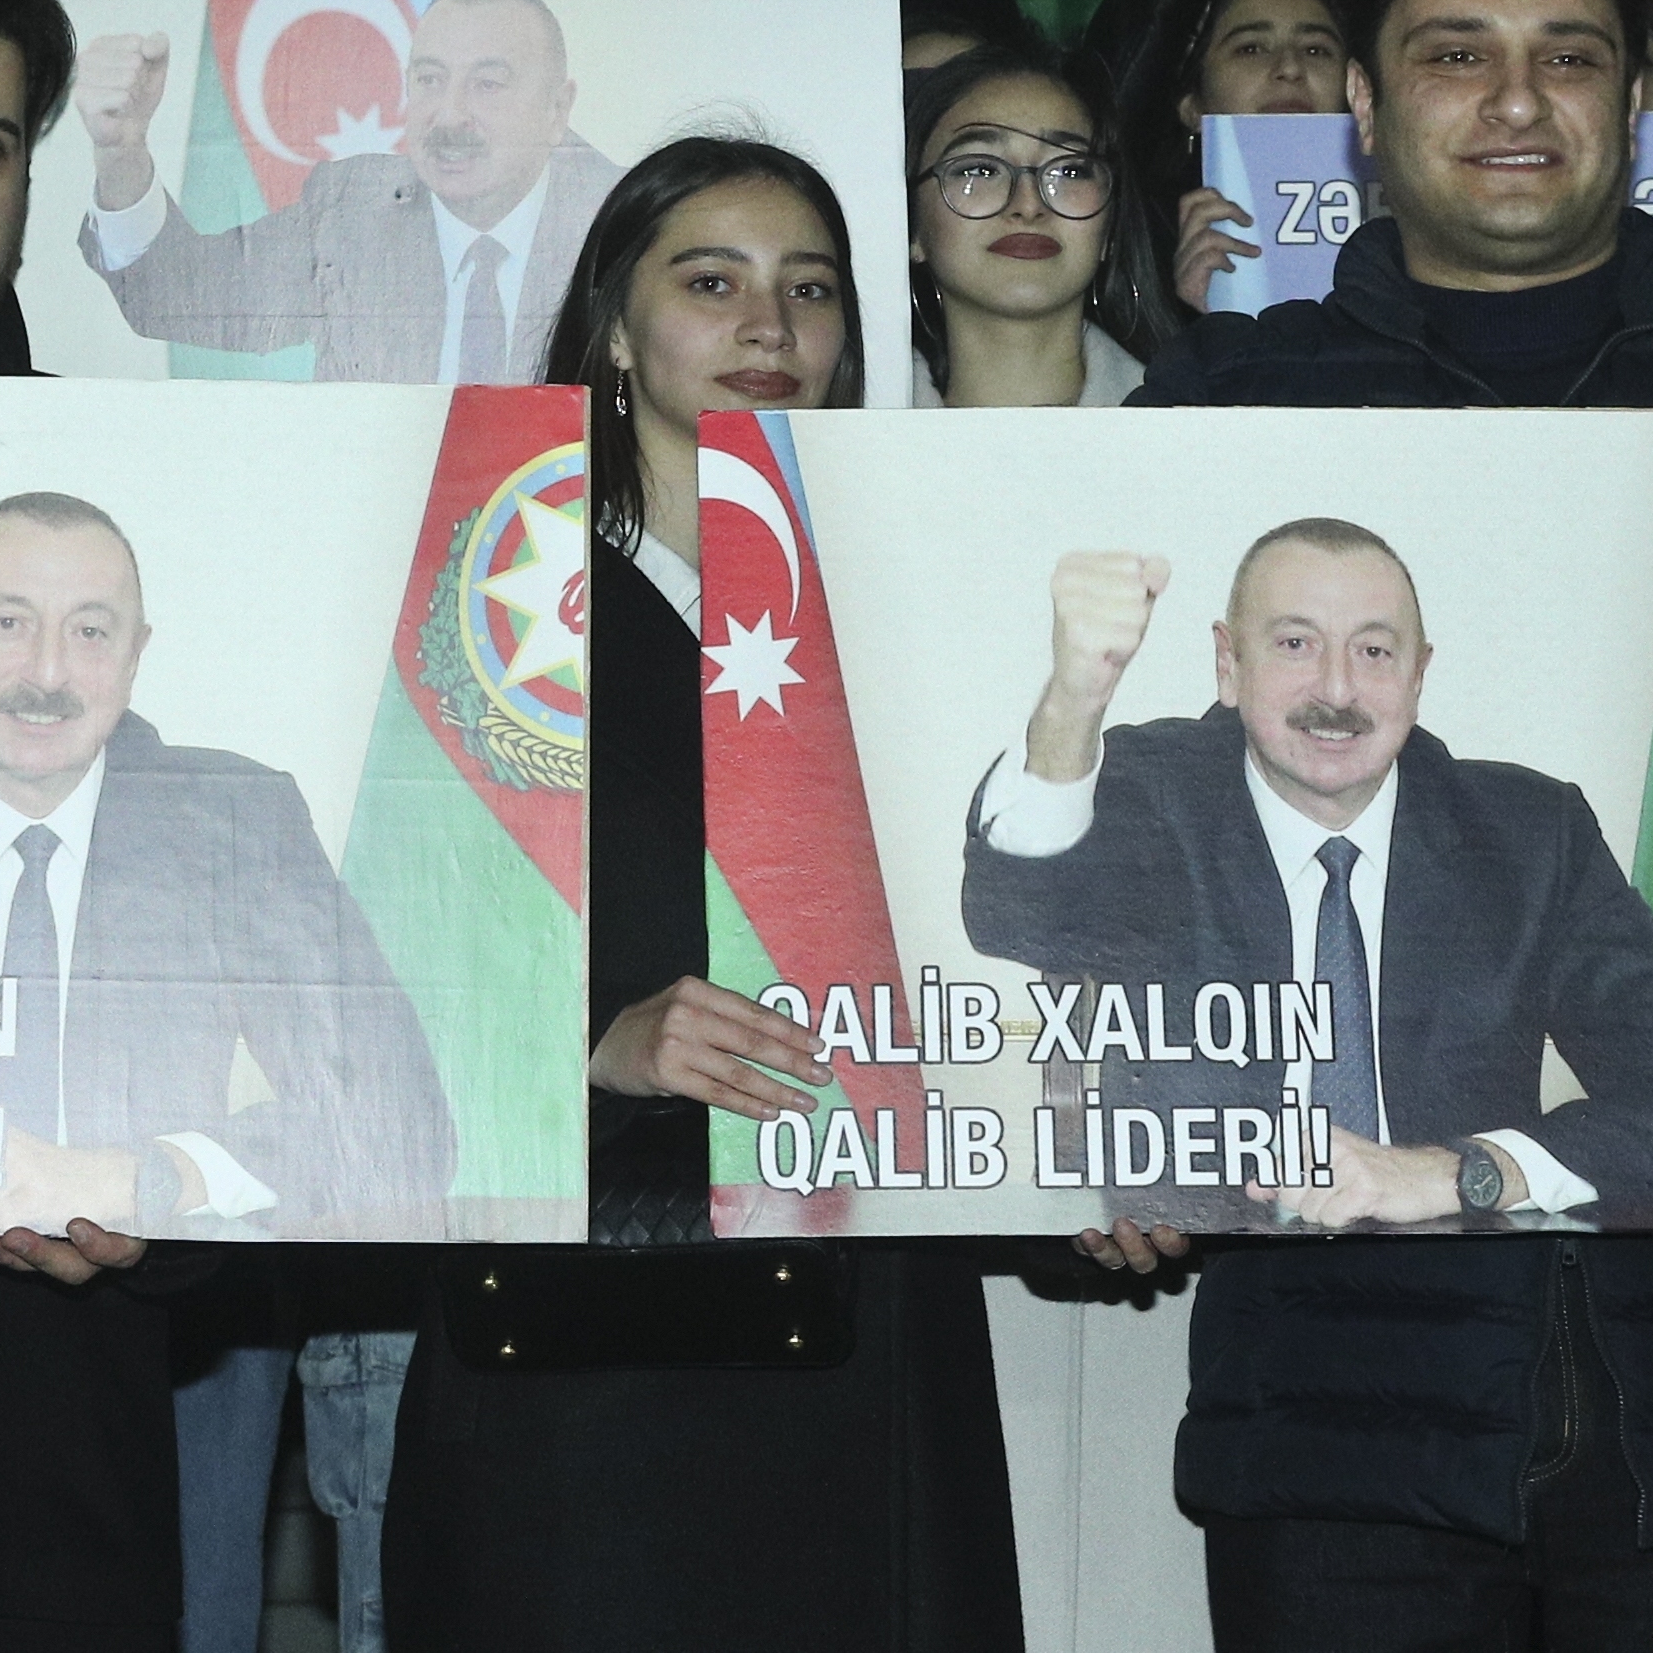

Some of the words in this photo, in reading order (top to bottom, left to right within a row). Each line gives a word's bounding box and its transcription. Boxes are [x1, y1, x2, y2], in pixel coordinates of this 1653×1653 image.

[1027, 980, 1336, 1069] XALQIN
[756, 1089, 1008, 1197] QALİB
[1033, 1088, 1334, 1190] LİDERİ!
